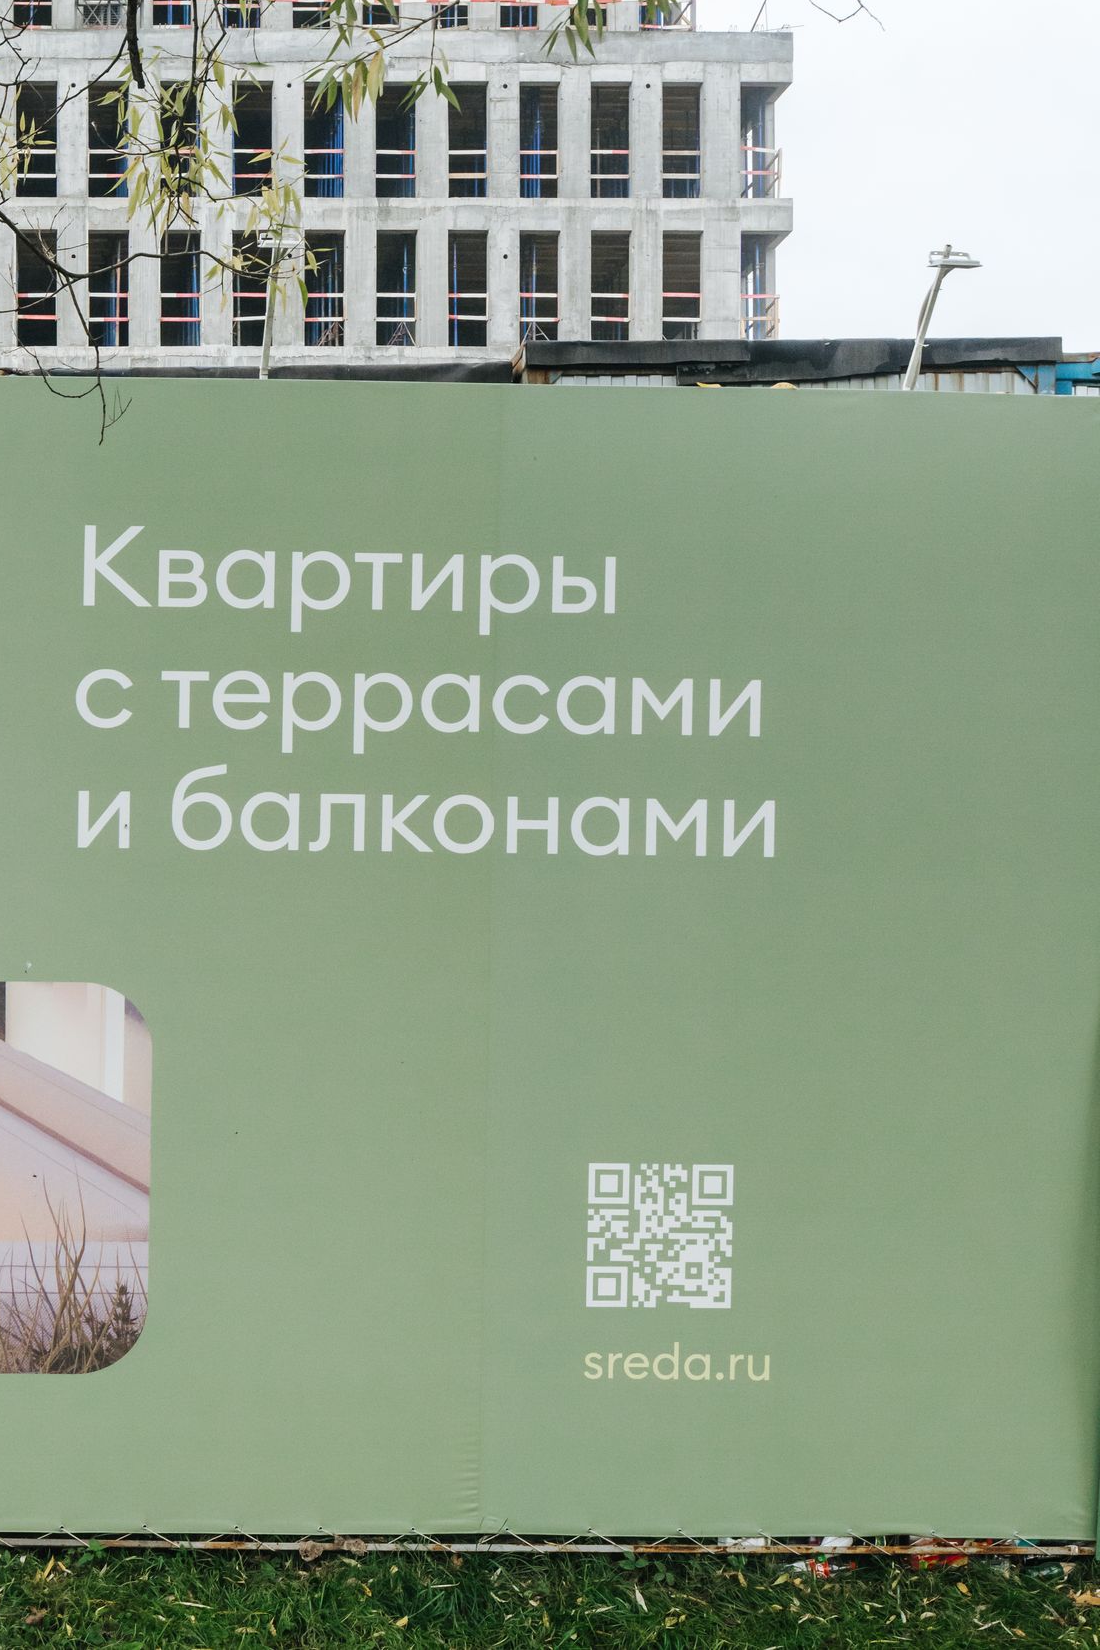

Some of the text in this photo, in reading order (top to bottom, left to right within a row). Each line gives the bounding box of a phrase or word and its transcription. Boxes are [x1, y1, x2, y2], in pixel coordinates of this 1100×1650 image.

[82, 524, 618, 636] Квартиры
[75, 668, 762, 755] с террасами
[77, 763, 776, 858] и балконами
[584, 1341, 771, 1382] sreda.ru
